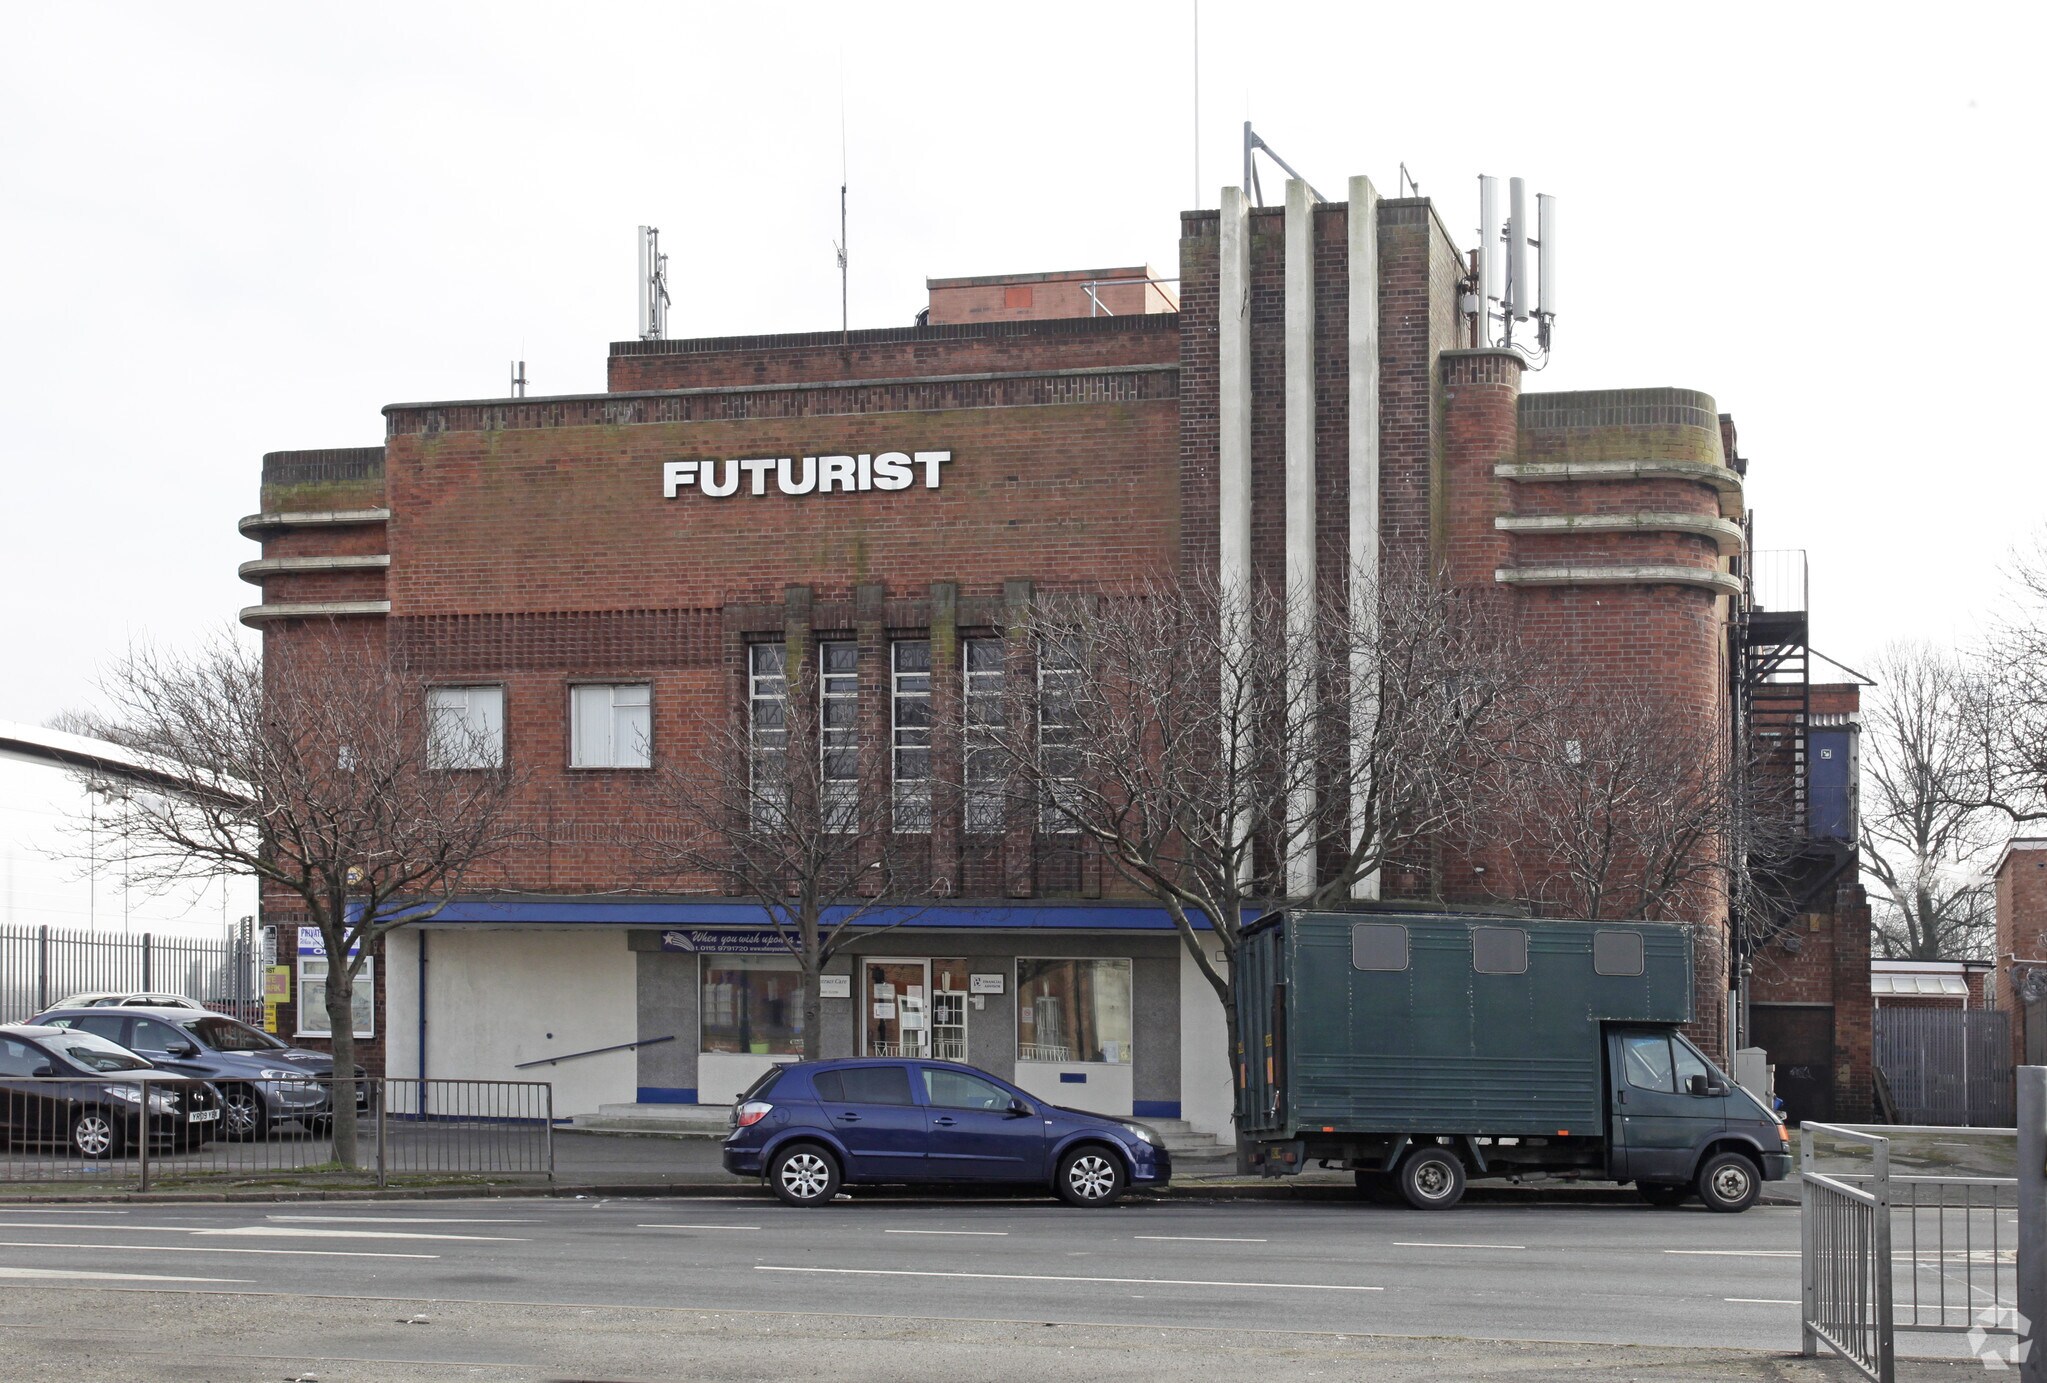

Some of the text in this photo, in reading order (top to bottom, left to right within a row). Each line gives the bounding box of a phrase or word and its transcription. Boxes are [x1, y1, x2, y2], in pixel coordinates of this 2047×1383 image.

[664, 452, 950, 498] FUTURIST
[692, 931, 717, 943] When
[721, 936, 738, 946] you
[739, 932, 761, 943] wish
